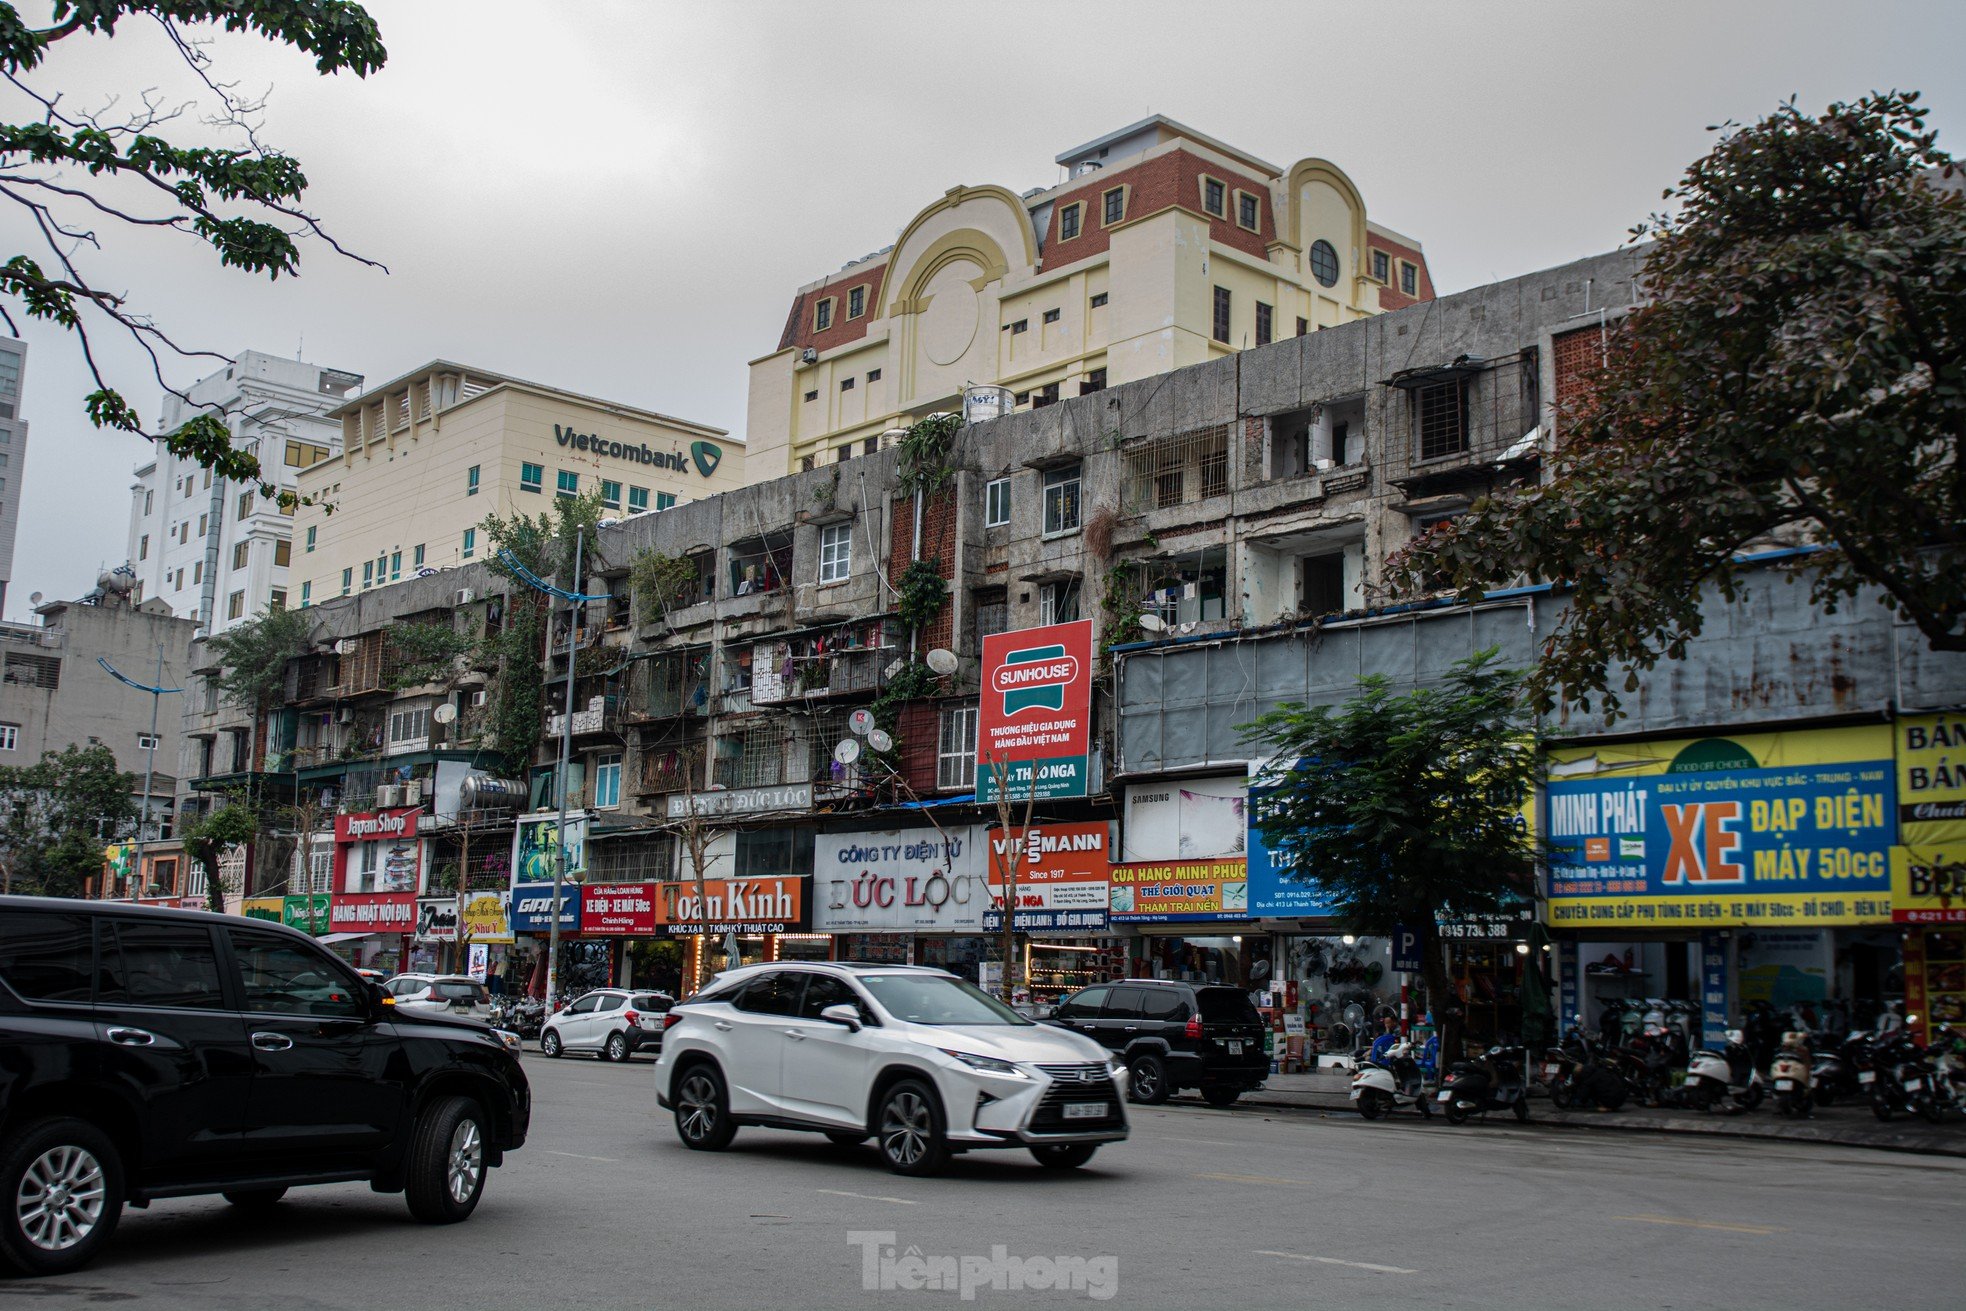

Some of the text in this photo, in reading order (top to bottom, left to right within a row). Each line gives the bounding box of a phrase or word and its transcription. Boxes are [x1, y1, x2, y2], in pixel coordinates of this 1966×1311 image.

[554, 423, 689, 474] Vietcombank
[1000, 662, 1070, 685] SUNHOUSE
[990, 719, 1076, 736] THƯƠNG HIỆU GIA DỤNG
[995, 733, 1070, 748] HÀNG ĐẦU VIỆT NAM
[1050, 764, 1076, 778] NGA
[736, 788, 771, 810] ĐỨC
[773, 786, 807, 807] LỘC
[1132, 793, 1169, 804] SAMSUNG
[1552, 793, 1598, 836] MINH
[1602, 782, 1648, 834] PHÁT
[347, 813, 406, 838] Japan Shop
[1661, 787, 1884, 885] XE ĐẠP ĐIỆN
[838, 844, 878, 863] CÔNG
[881, 845, 901, 861] TY
[904, 840, 938, 863] ĐIỆN
[1754, 842, 1811, 880] MÁY
[1818, 847, 1884, 878] 50cc
[1029, 869, 1064, 879] Since 1917
[1112, 861, 1247, 882] CỬA HÀNG MINH PHÚC
[1141, 882, 1214, 897] THẾ GIỚI QUẠT
[586, 896, 650, 915] XE ĐIỆN XE MÁY 50cc
[663, 880, 793, 921] Toàn Kính
[1023, 895, 1044, 908] NGA
[1197, 897, 1219, 911] NỀN
[1554, 903, 1587, 919] CHUYÊN
[1591, 904, 1614, 918] CUNG
[1617, 900, 1634, 918] CẤP
[1637, 904, 1655, 921] PHỤ
[1658, 901, 1681, 918] TÙNG
[1684, 903, 1695, 917] XE
[1699, 901, 1721, 920] ĐIỆN
[1730, 903, 1742, 917] XE
[1746, 900, 1766, 917] MÁY
[1769, 902, 1794, 917] 50cc
[1803, 898, 1817, 916] ĐỒ
[1821, 900, 1844, 916] CHƠI
[1855, 899, 1876, 915] ĐÈN
[333, 899, 357, 922] HÀNG
[357, 899, 379, 926] NHẬT
[379, 898, 395, 926] NỘI
[395, 903, 412, 926] ĐỊA
[602, 916, 618, 925] Chính
[1014, 911, 1104, 930] ĐIỆN ĐỒ GIA DỤNG
[1920, 911, 1942, 920] 421
[475, 922, 491, 934] Như
[668, 922, 784, 935] KHÚC XẠ KÍNH KỸ THUẬT CAO
[1402, 933, 1415, 954] P
